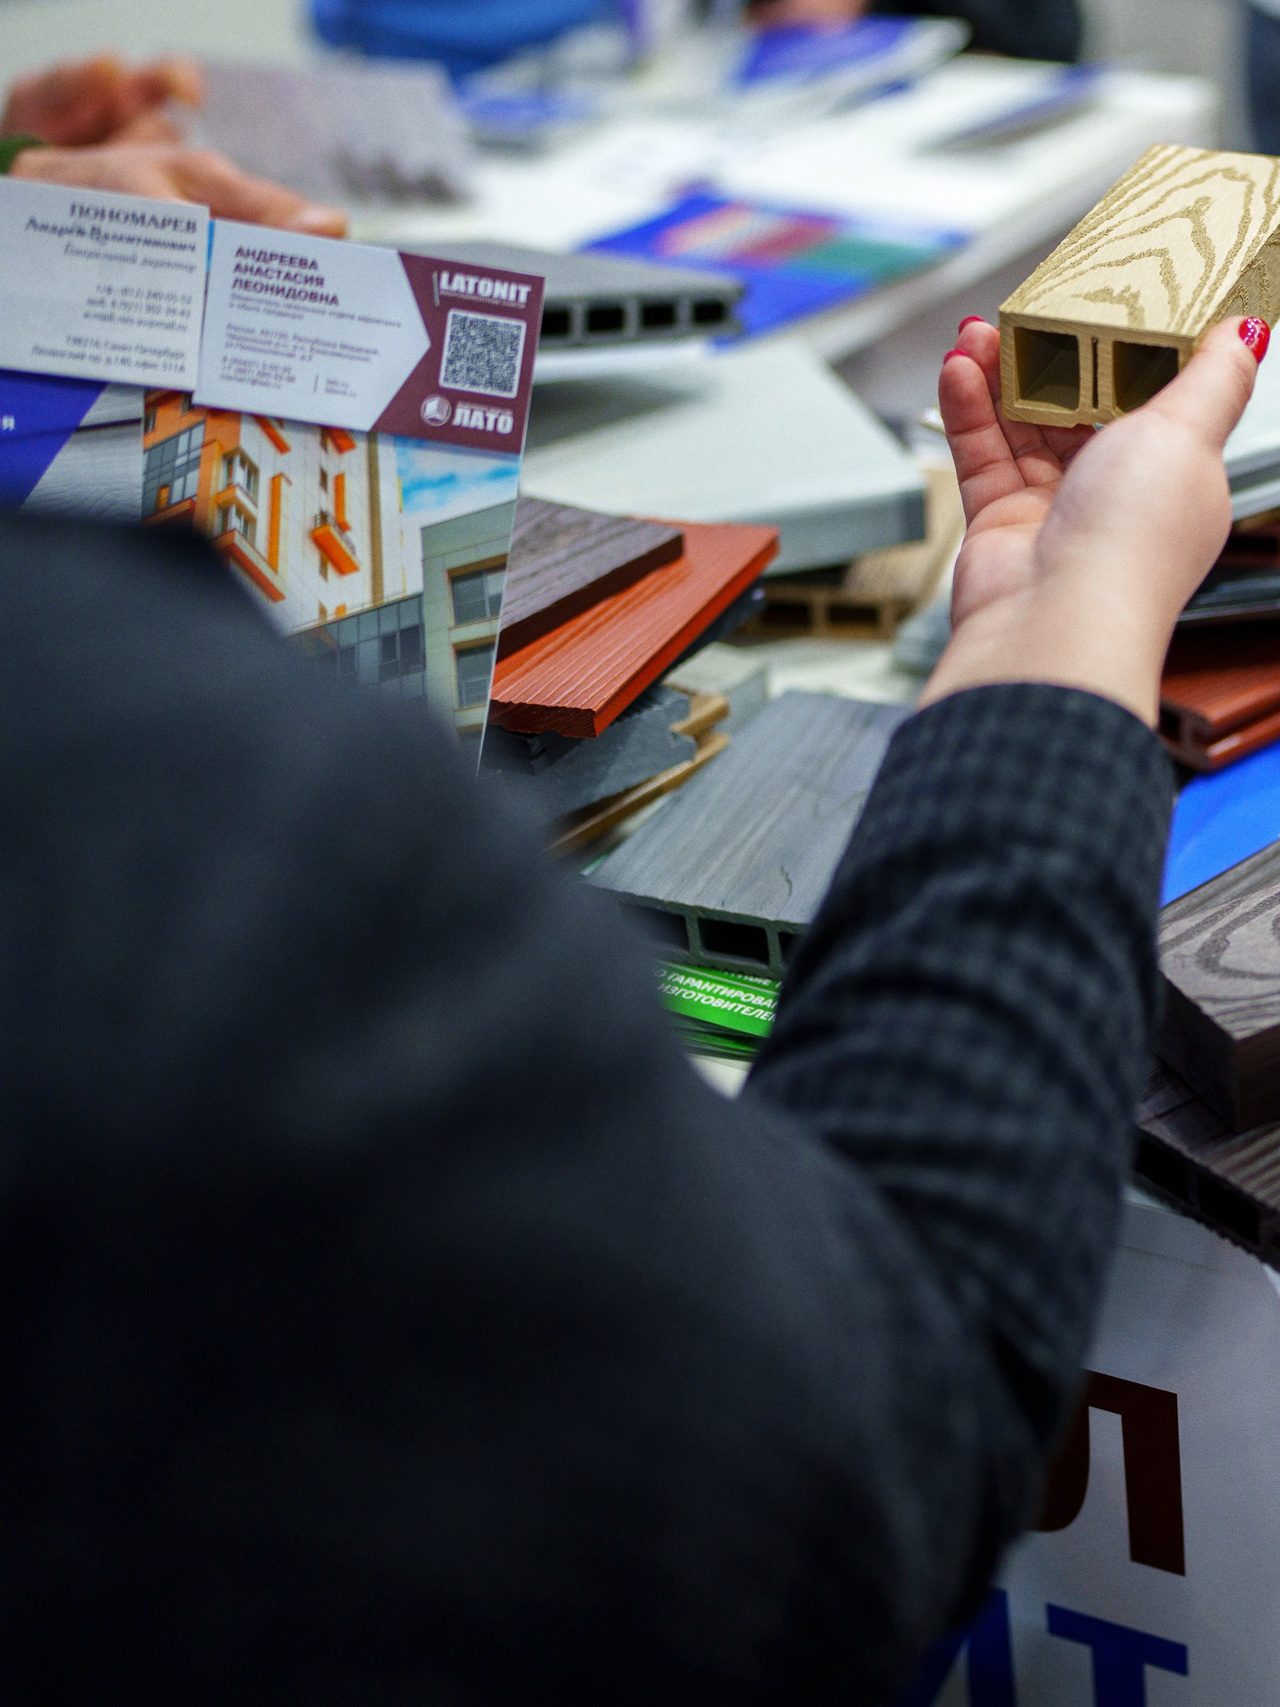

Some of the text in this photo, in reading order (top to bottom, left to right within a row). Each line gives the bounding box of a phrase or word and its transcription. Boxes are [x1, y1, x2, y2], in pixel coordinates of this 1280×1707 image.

[70, 203, 197, 233] ПОНОМАРЕВ
[235, 246, 319, 270] АНДРЕЕВА
[233, 262, 325, 288] АНАСТАСИЯ
[439, 270, 532, 304] LATONIT
[232, 276, 340, 306] ЛЕОНИДОВНА
[452, 407, 514, 434] ЛАТО
